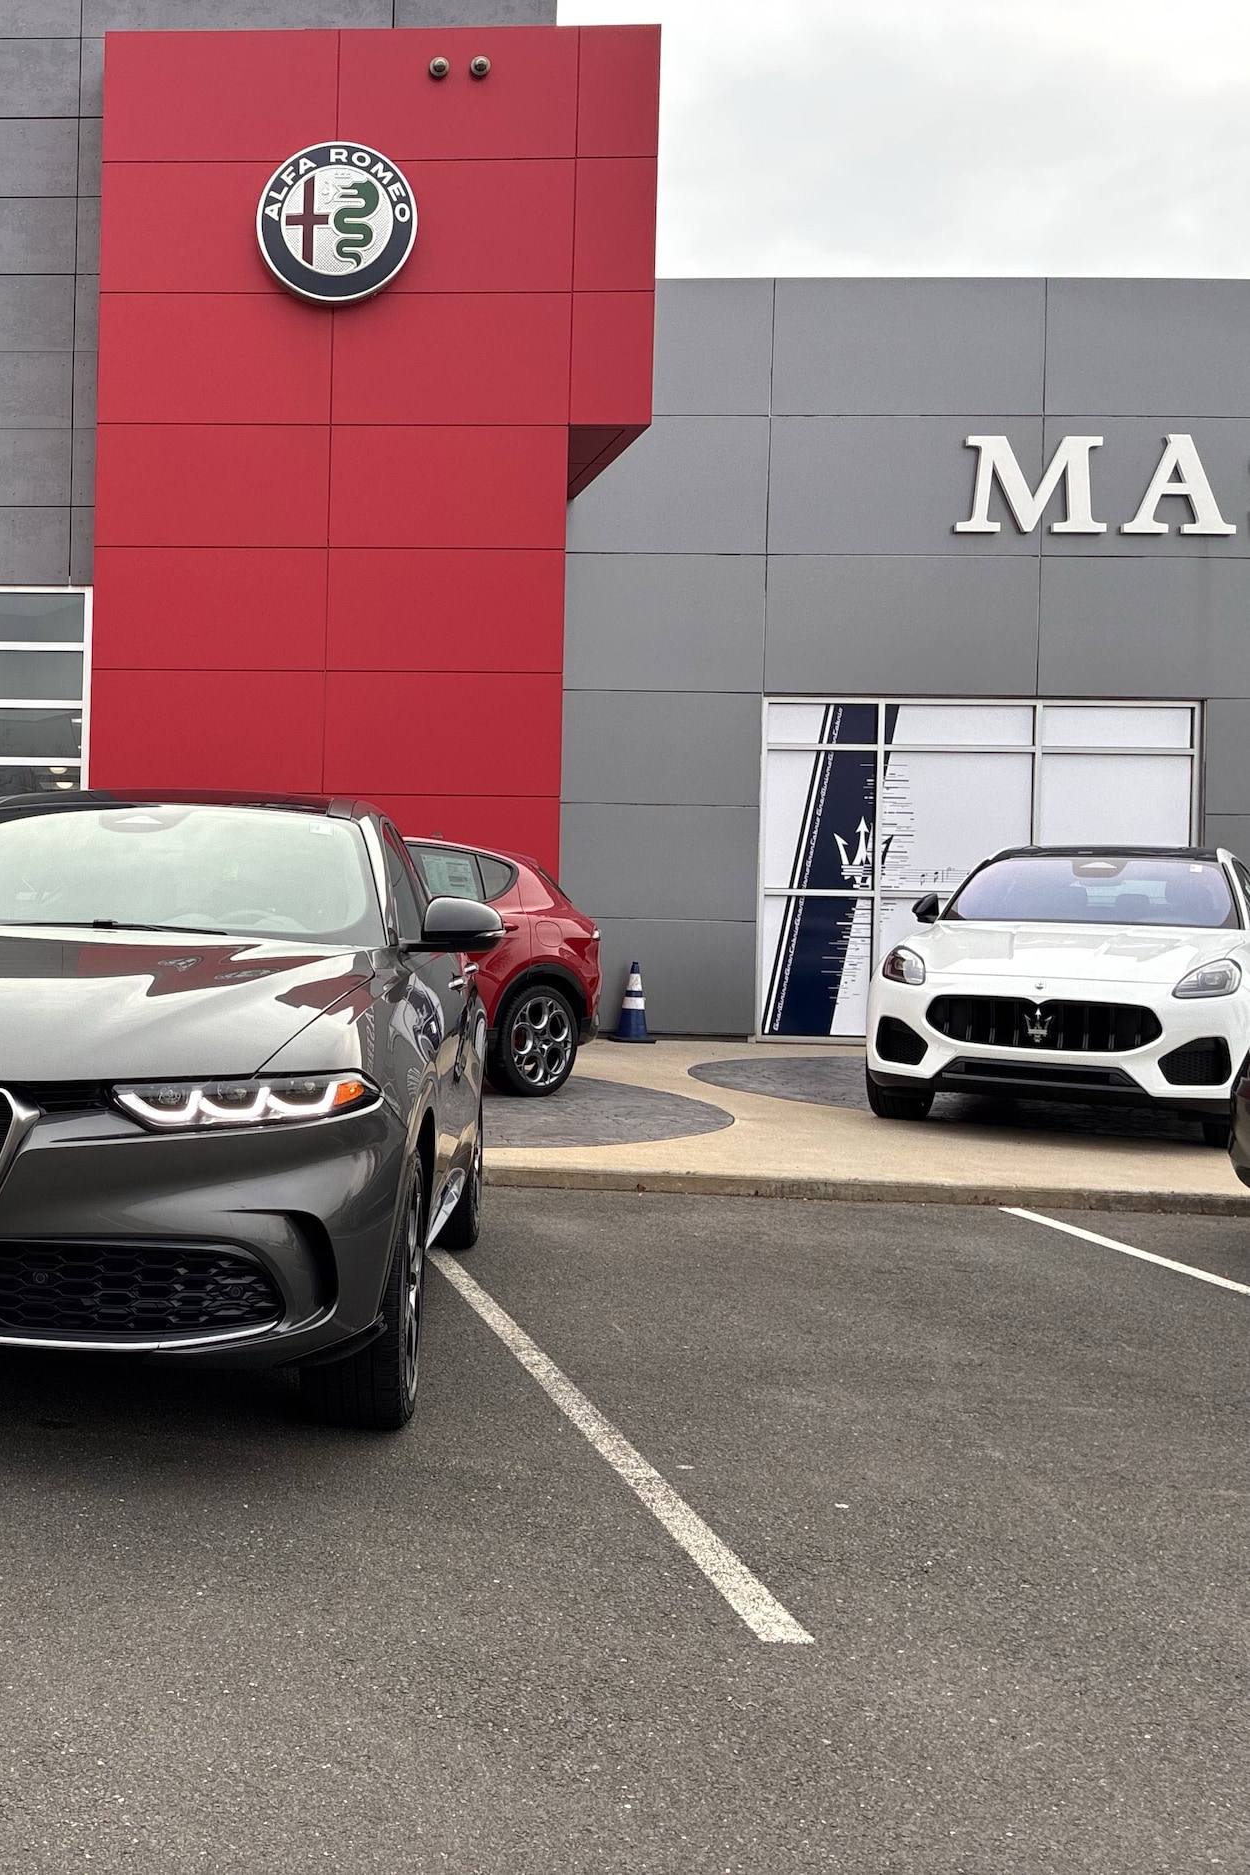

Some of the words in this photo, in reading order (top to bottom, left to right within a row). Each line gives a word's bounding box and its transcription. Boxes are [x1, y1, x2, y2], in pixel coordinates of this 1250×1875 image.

[264, 157, 317, 221] ALFA
[329, 148, 411, 223] ROMEO
[953, 433, 1250, 535] MA
